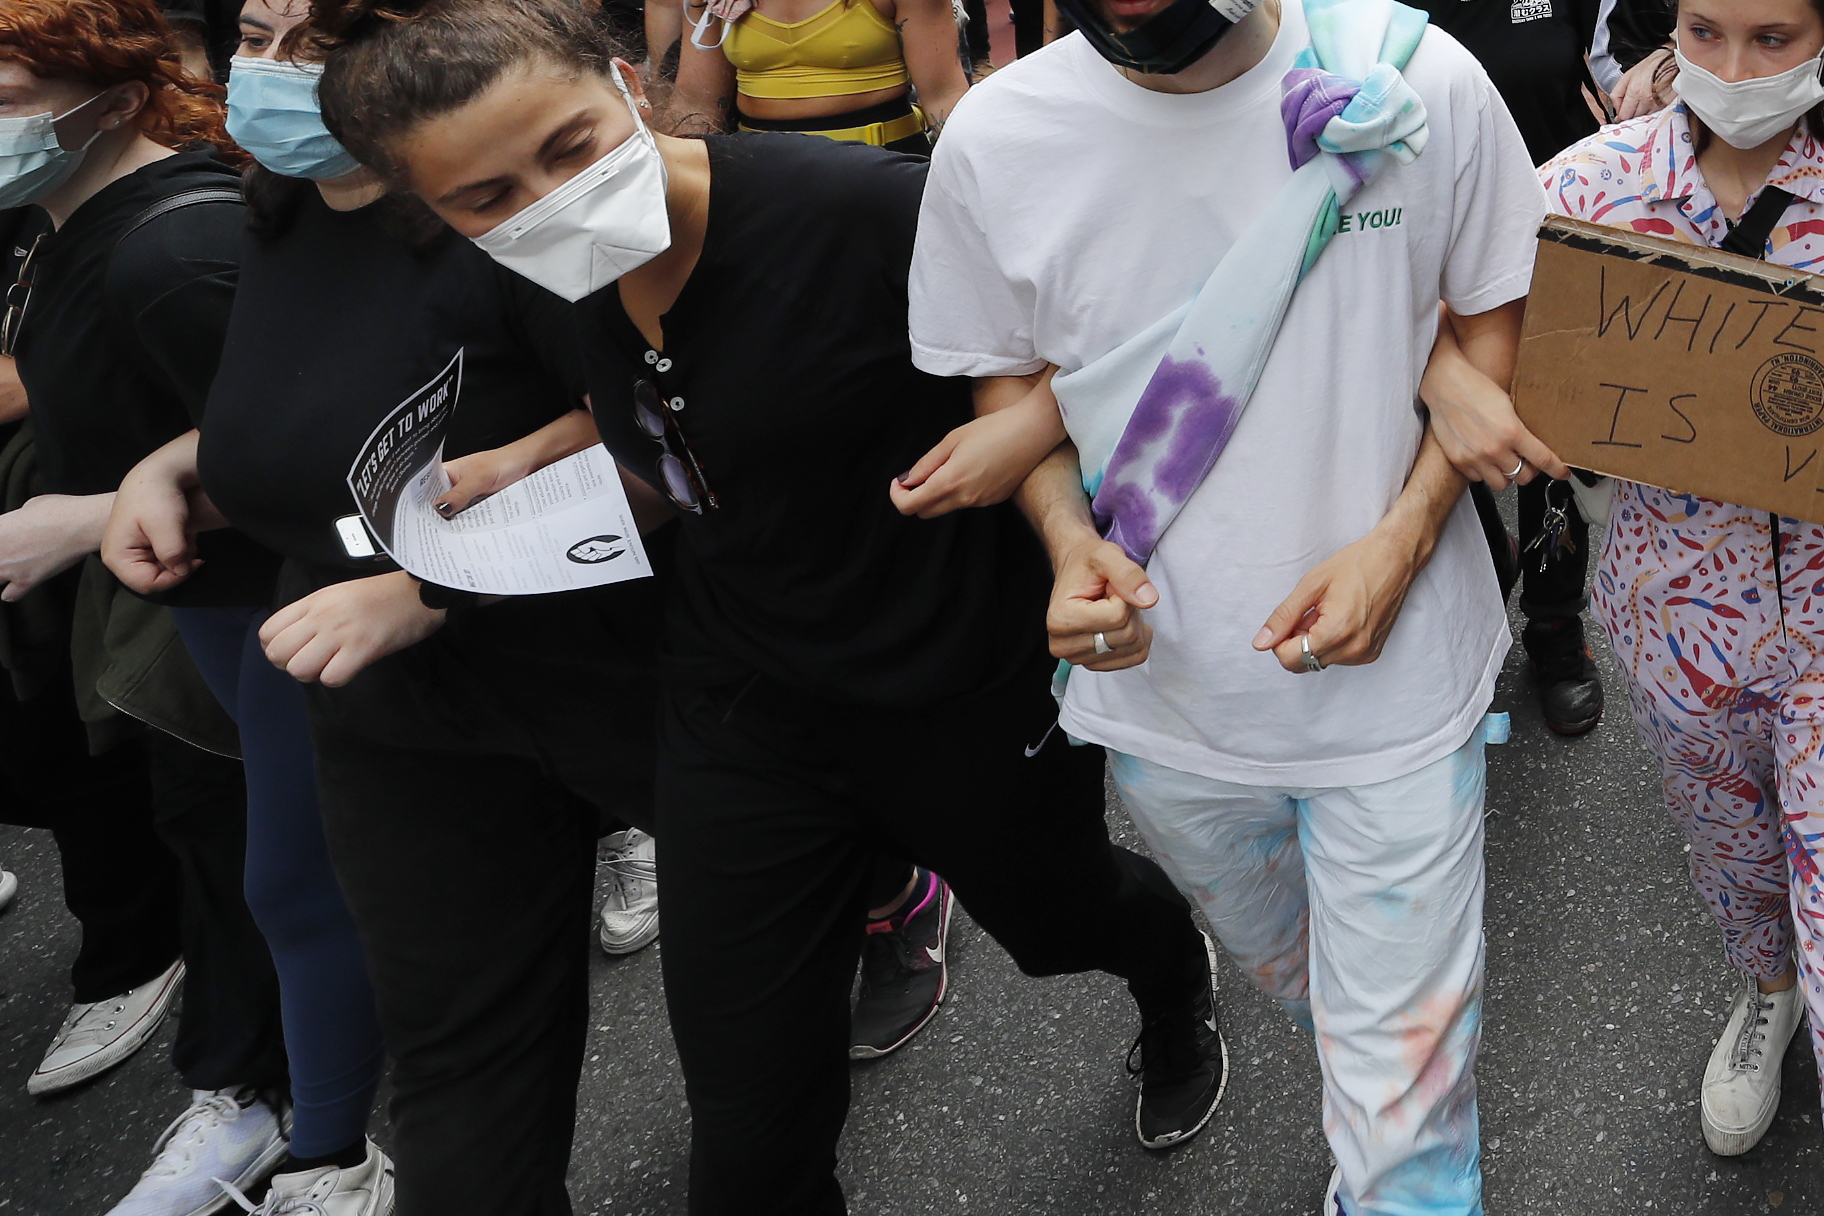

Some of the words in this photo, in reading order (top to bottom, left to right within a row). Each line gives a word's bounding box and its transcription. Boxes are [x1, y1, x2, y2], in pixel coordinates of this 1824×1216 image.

[1358, 208, 1402, 231] YOU!
[1770, 357, 1780, 367] NJ
[1783, 388, 1805, 398] CRUSH
[1805, 393, 1822, 403] EDGE
[1808, 388, 1823, 397] TEST
[1592, 384, 1698, 448] IS
[1753, 401, 1771, 424] PAPER
[1770, 417, 1824, 435] INTERNATIONAL
[377, 427, 395, 463] GET
[398, 411, 413, 438] TO
